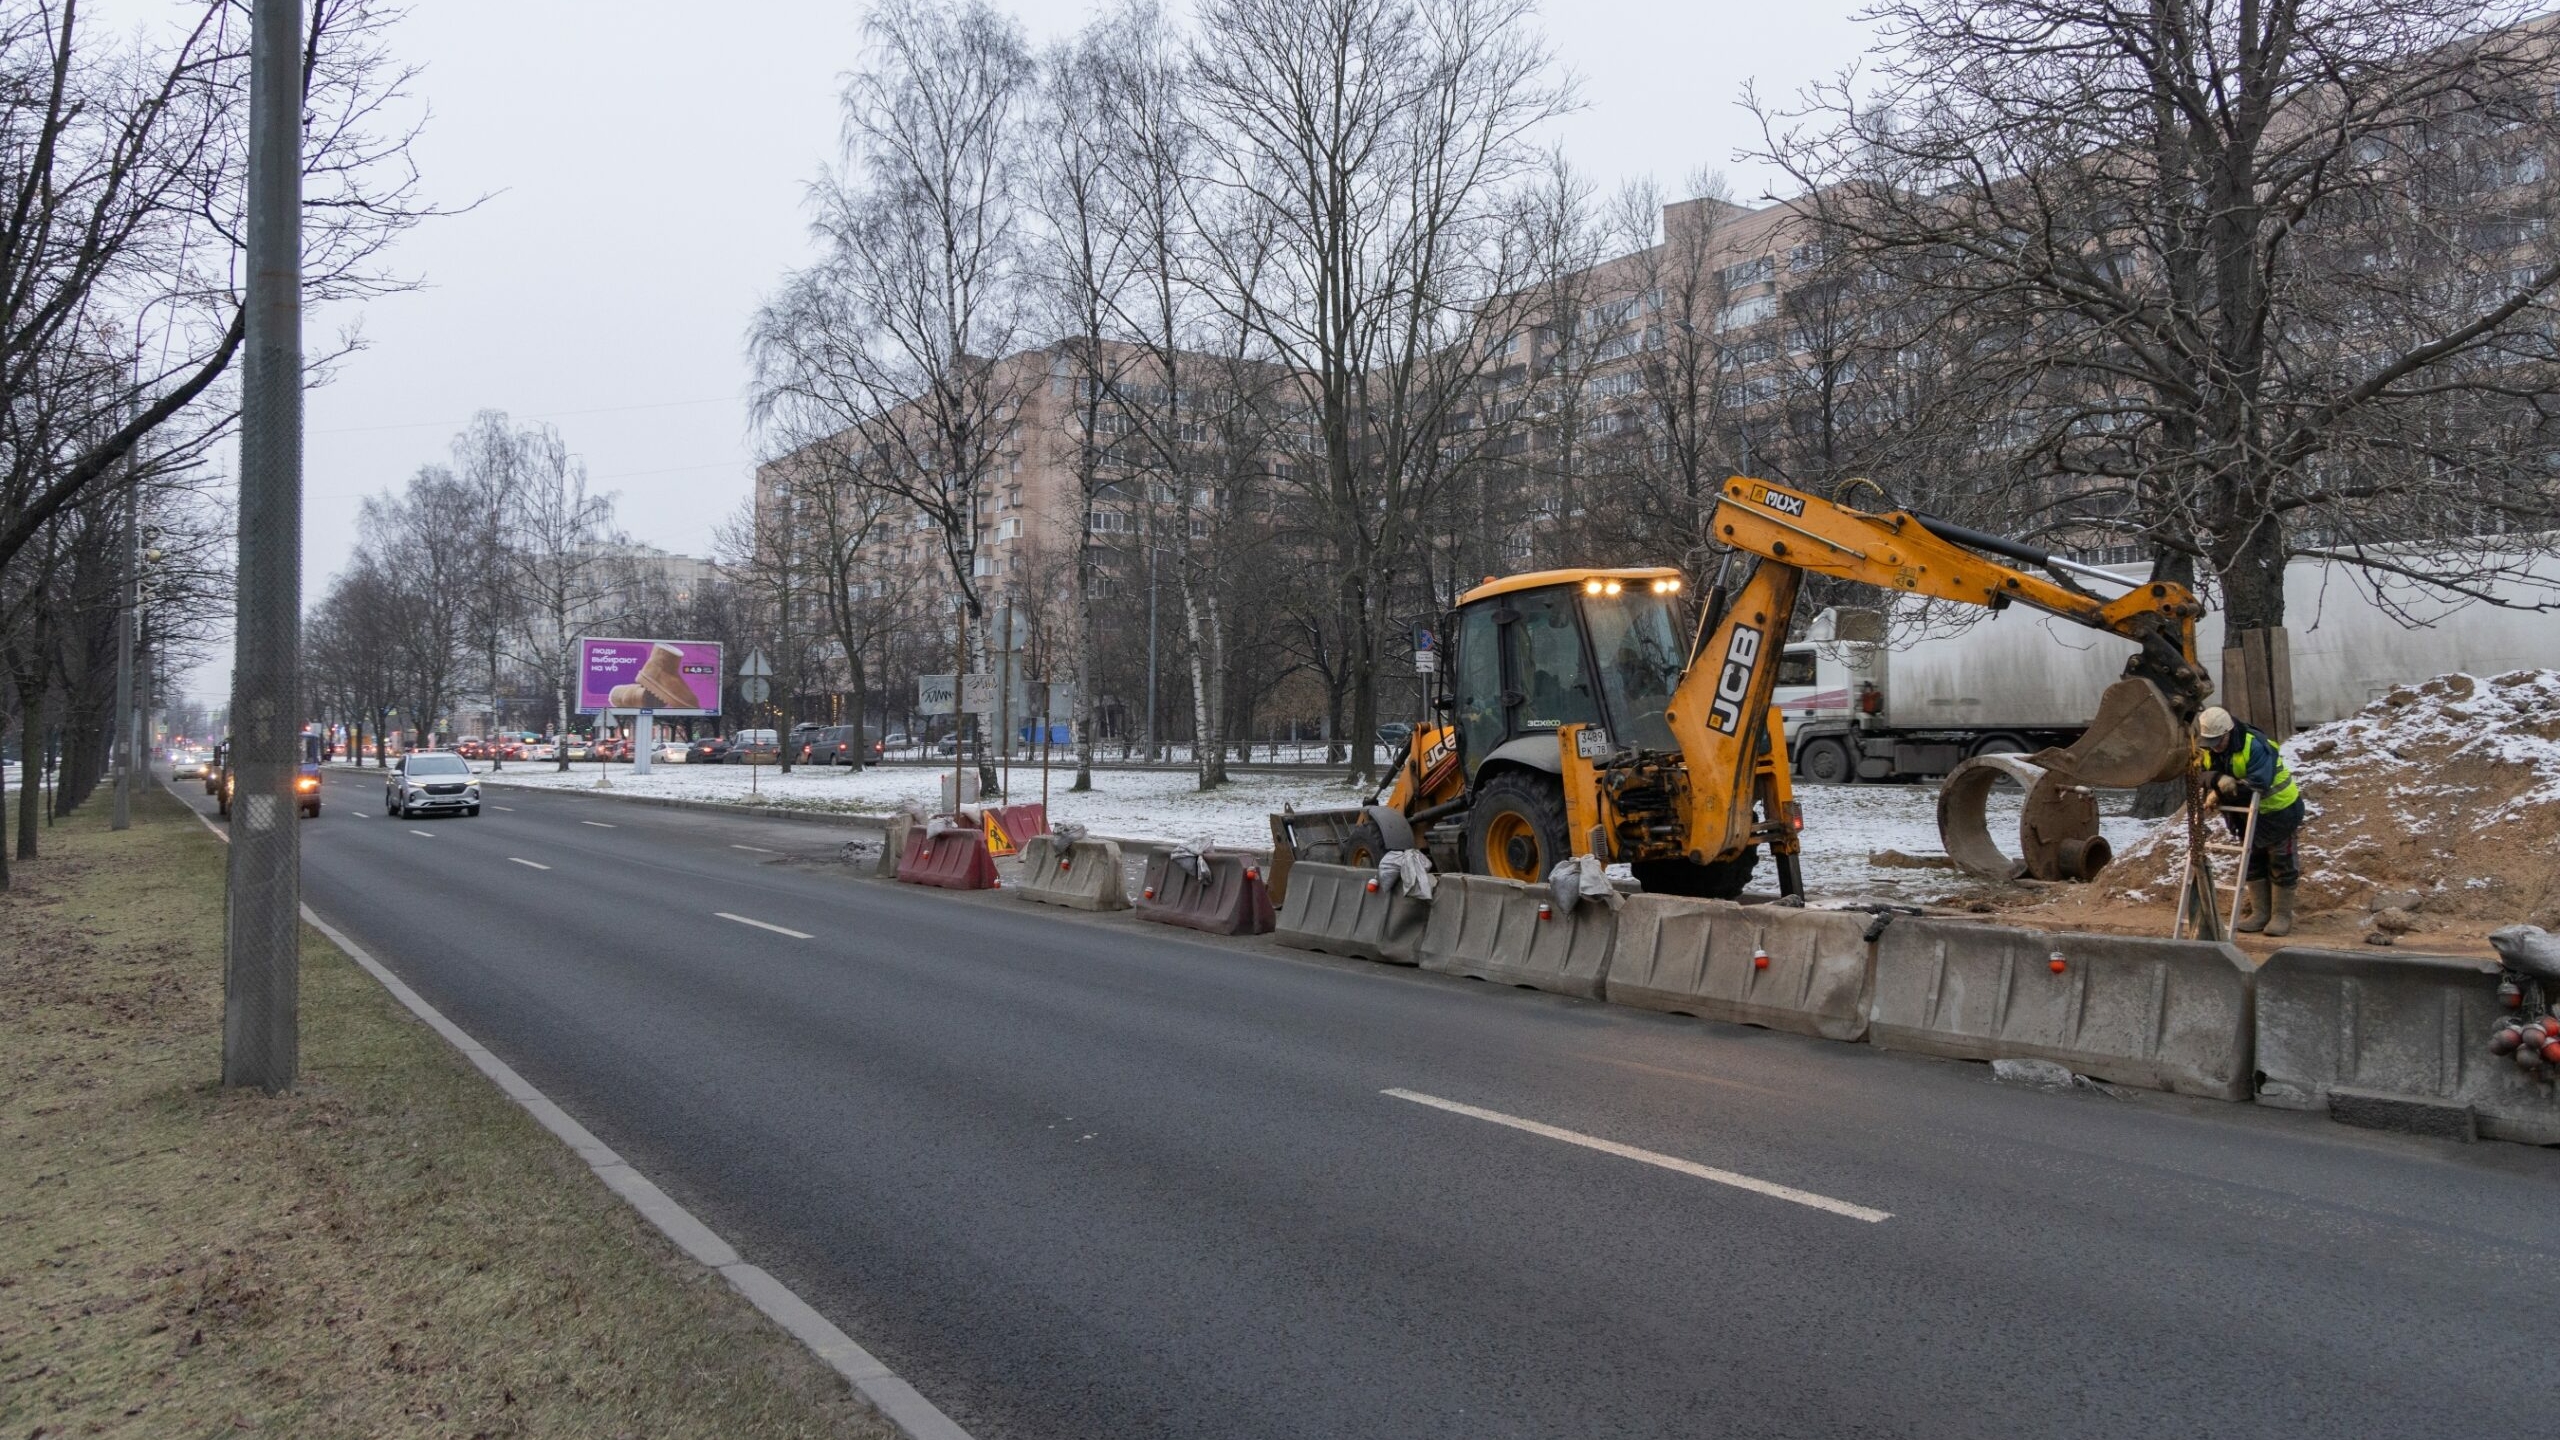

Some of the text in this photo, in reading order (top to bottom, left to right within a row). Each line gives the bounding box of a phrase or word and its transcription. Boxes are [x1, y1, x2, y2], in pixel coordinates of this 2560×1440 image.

[591, 656, 637, 664] выбирают
[605, 664, 618, 672] wb
[1714, 627, 1761, 733] JCB
[1581, 732, 1603, 743] 3489
[1426, 733, 1457, 768] JCB
